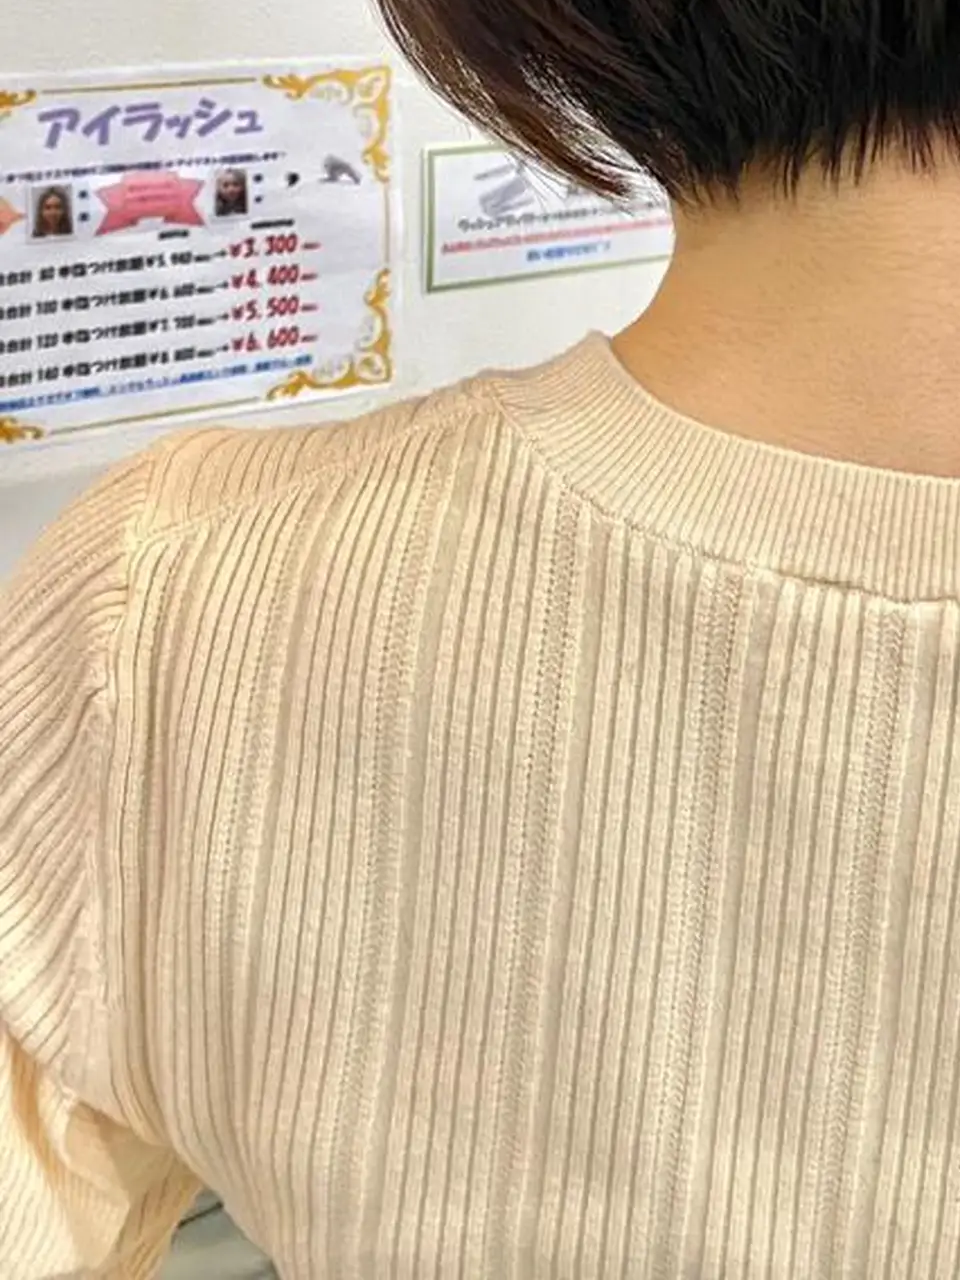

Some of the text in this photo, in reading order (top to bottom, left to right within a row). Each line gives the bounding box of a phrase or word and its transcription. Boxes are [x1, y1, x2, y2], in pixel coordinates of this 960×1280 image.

[38, 98, 263, 149] アイラッシュ
